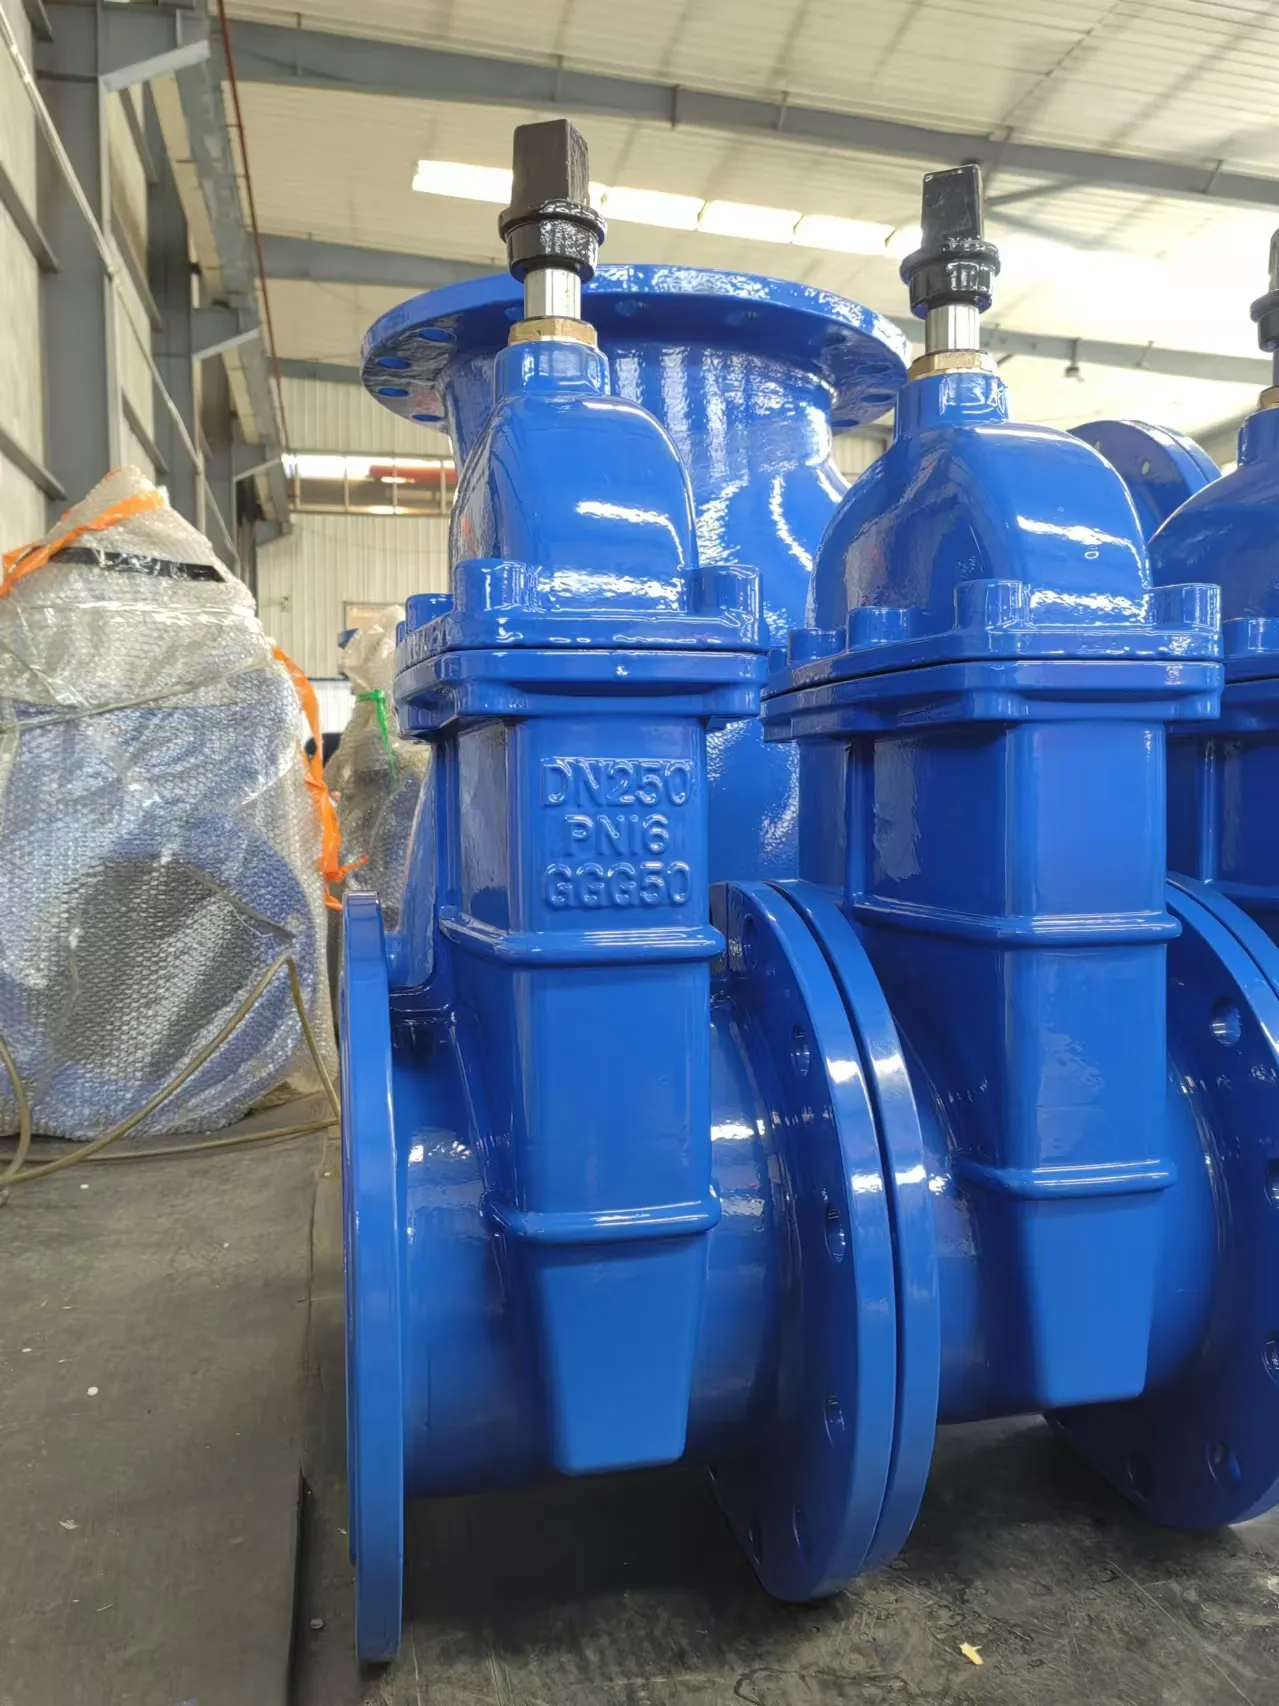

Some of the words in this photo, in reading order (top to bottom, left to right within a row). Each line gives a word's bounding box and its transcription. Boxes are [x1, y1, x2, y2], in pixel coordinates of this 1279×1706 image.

[541, 757, 693, 807] DN250
[564, 813, 670, 857] PN16
[544, 861, 691, 908] GGG50
